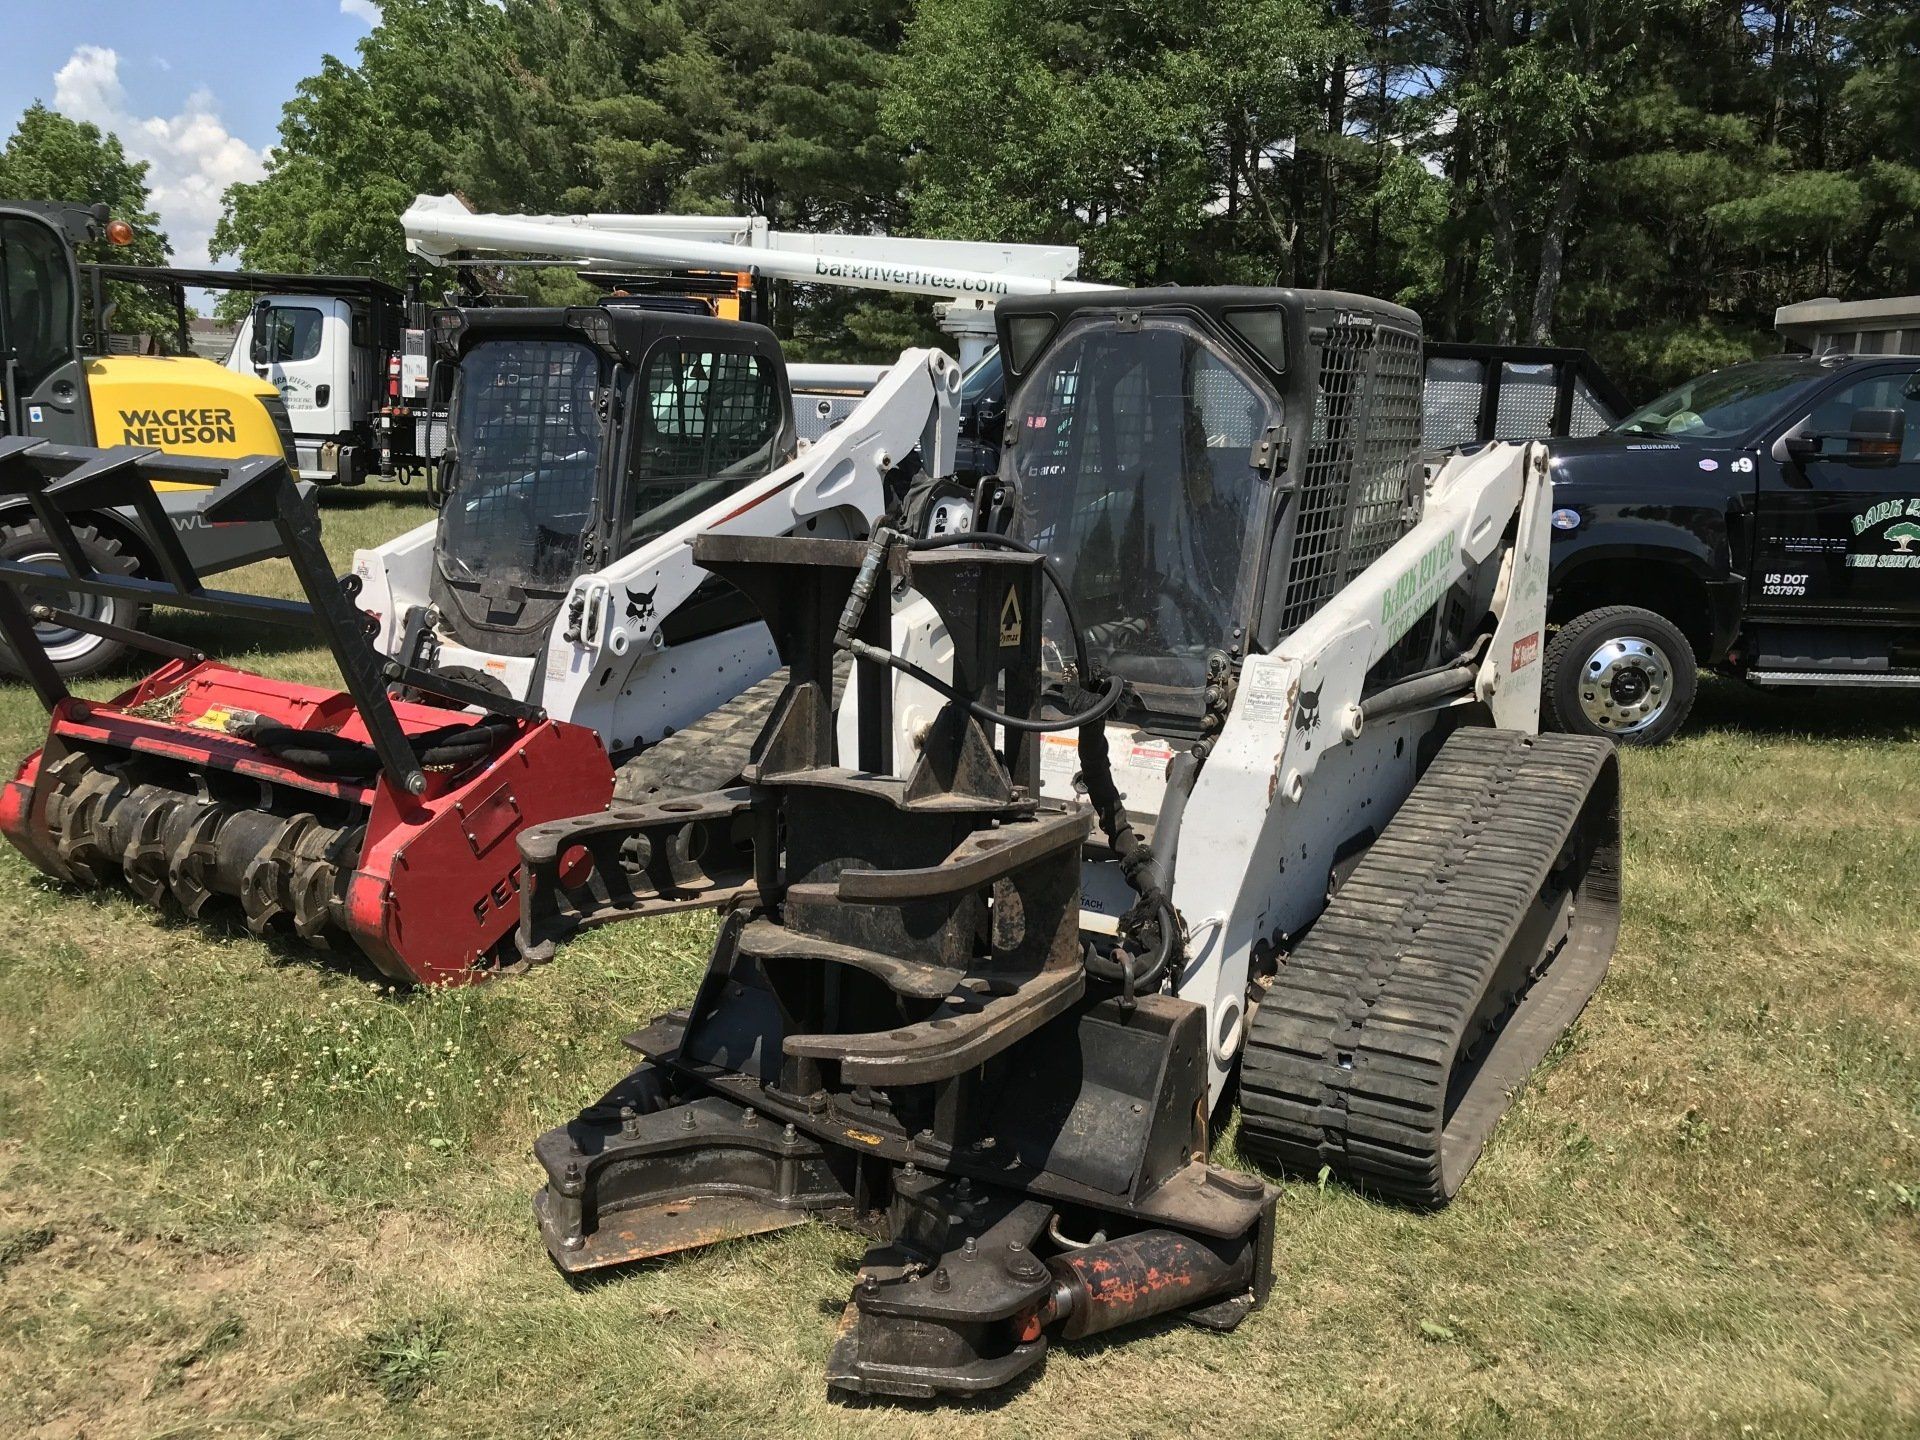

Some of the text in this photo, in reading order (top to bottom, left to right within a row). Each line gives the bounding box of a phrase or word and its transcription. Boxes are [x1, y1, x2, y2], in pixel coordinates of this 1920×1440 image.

[815, 257, 1008, 295] barkrivertree.com
[118, 408, 235, 427] WACKER
[422, 410, 435, 418] DT
[123, 426, 237, 446] NEUSON
[1730, 457, 1754, 473] #9
[1851, 498, 1905, 536] BARK
[1846, 553, 1878, 568] TREE
[1381, 563, 1418, 626] BARK
[1418, 529, 1455, 591] RIVER
[1764, 573, 1809, 585] US DOT
[1762, 585, 1806, 596] 1337979
[1387, 605, 1414, 650] TREE
